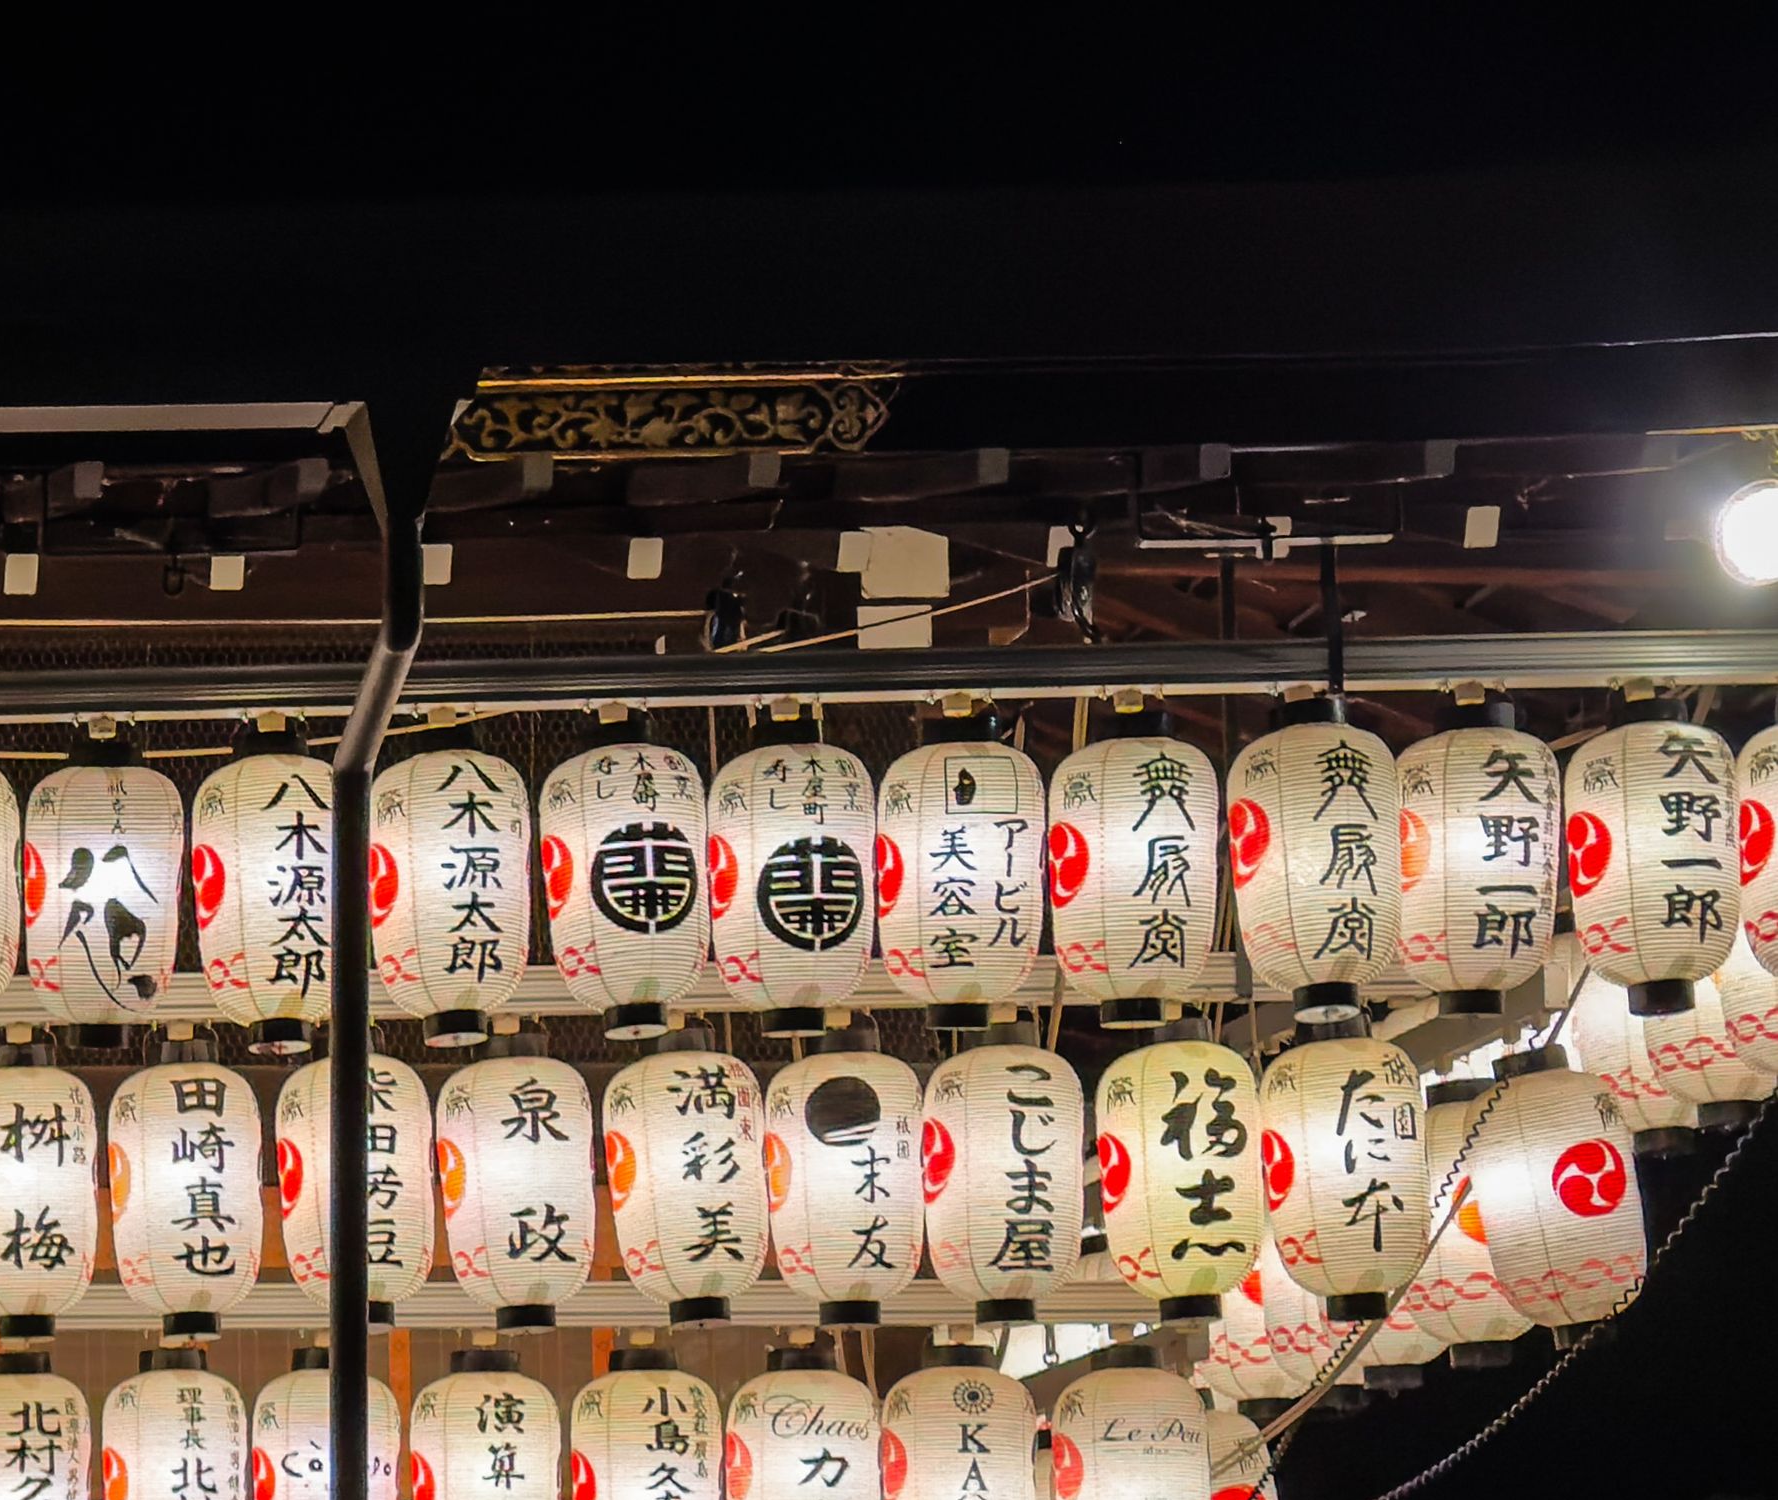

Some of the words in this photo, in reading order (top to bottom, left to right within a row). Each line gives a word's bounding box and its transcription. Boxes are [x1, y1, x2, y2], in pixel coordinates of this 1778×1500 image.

[263, 773, 331, 999] 八木源太郎
[436, 759, 505, 982] 八木源太郎
[929, 826, 980, 969] 美容室
[988, 820, 1028, 949] アービル
[1473, 746, 1541, 960] 矢野一郎
[1657, 730, 1724, 943] 矢野一郎
[0, 1102, 75, 1269] 桝梅
[171, 1075, 236, 1278] 田崎真也
[503, 1077, 576, 1264] 泉政
[666, 1065, 744, 1262] 満彩美
[986, 1063, 1056, 1272] こじま屋
[1337, 1069, 1403, 1252] たに本
[1383, 1054, 1416, 1140] 祇園
[848, 1146, 896, 1269] 末友
[176, 1387, 205, 1450] 理事長
[764, 1395, 870, 1441] Chaos
